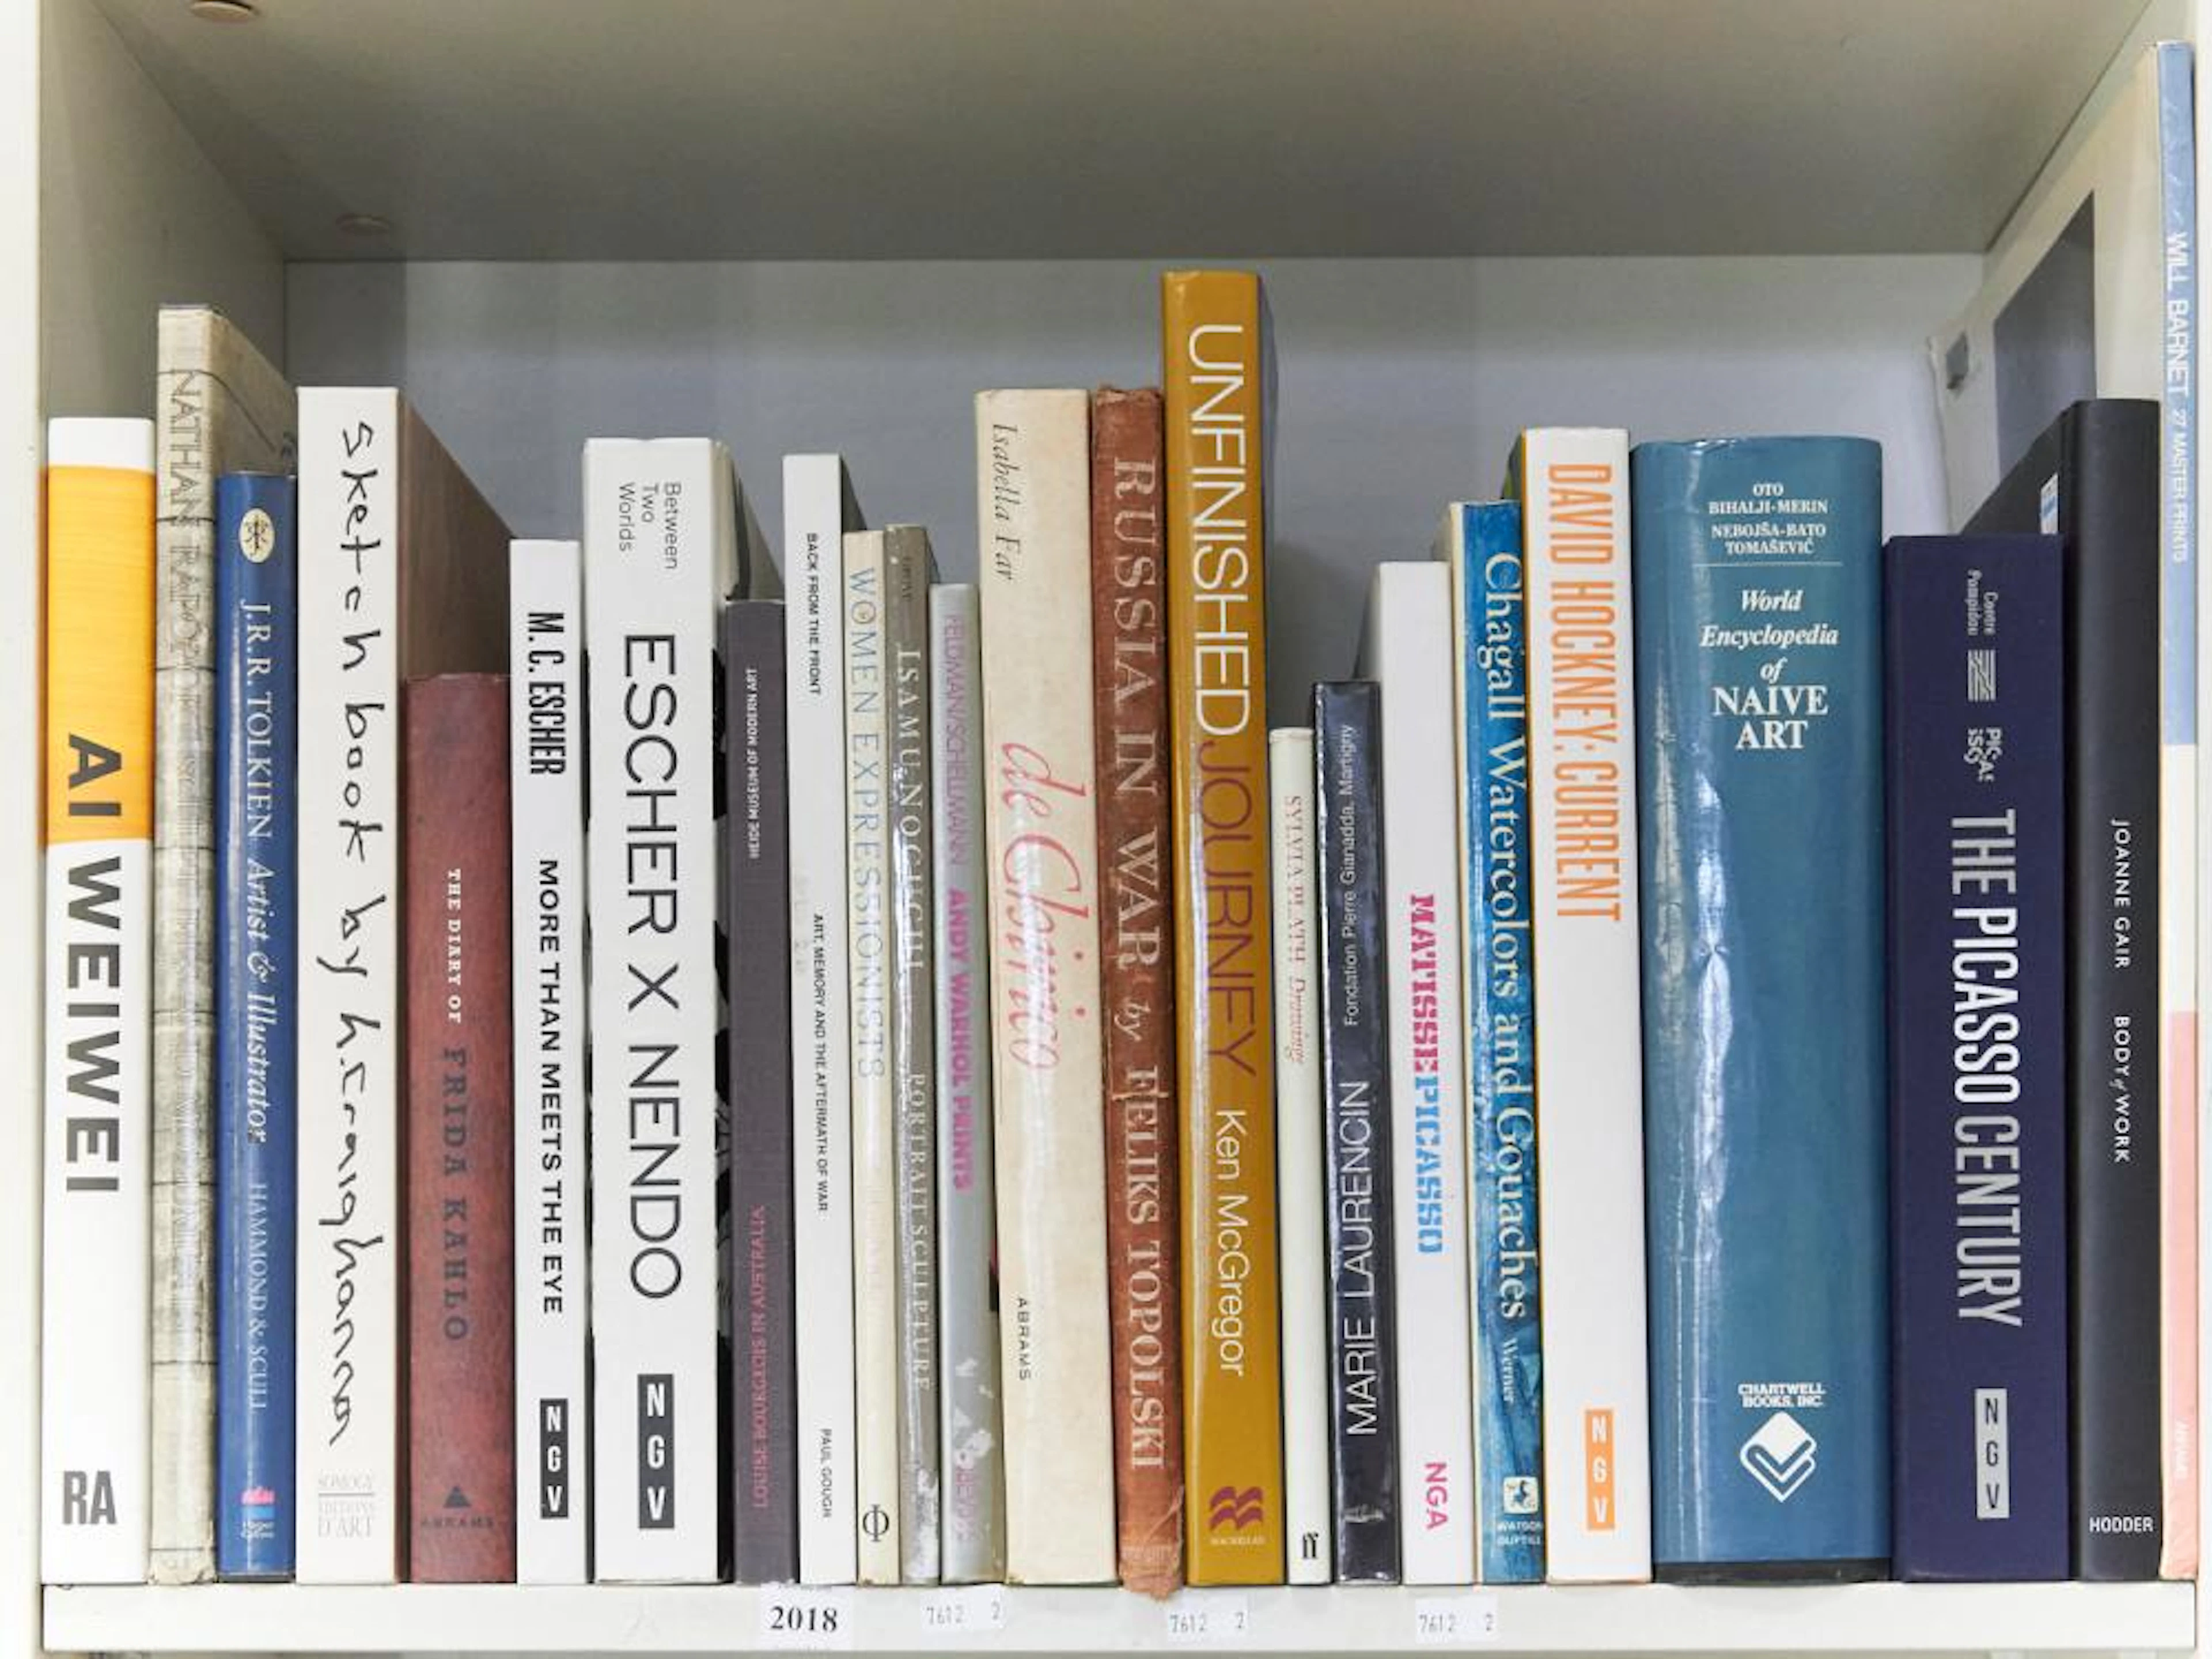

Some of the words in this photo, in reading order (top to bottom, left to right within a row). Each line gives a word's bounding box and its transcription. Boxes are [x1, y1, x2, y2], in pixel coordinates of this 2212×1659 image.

[2167, 231, 2188, 289] WILL
[2168, 298, 2190, 397] BARNET
[170, 372, 202, 529] NATHAN
[2171, 409, 2186, 426] 27
[993, 424, 1019, 520] Isabella
[1753, 483, 1784, 497] OTO
[2172, 433, 2187, 497] MASTER
[618, 482, 635, 552] Worlds
[641, 484, 658, 523] Two
[664, 482, 681, 569] Between
[1189, 323, 1250, 735] UNFINISHED
[1550, 464, 1613, 564] DAVID
[1709, 500, 1828, 514] BIHALJI-MERIN
[2172, 503, 2188, 562] PRINTS
[342, 422, 381, 671] sketch
[806, 533, 819, 570] BACK
[994, 534, 1019, 580] Far
[1113, 457, 1157, 704] RUSSIA
[529, 612, 564, 642] M.
[808, 576, 819, 615] FROM
[1741, 590, 1804, 611] World
[1965, 569, 1983, 635] Pompidou
[1983, 592, 1999, 634] Centre
[240, 599, 273, 685] J.R.R.
[529, 650, 565, 671] C.
[808, 620, 820, 645] THE
[850, 568, 880, 713] WOMEN
[1478, 553, 1527, 719] Chagall
[1699, 624, 1839, 650] Encyclopedia
[746, 668, 758, 691] ART
[809, 650, 821, 695] FRONT
[1711, 685, 1828, 715] NAIVE
[1760, 657, 1788, 683] of
[529, 681, 566, 775] ESCHER
[747, 693, 759, 746] MODERN
[897, 649, 921, 767] ISAMU
[1735, 721, 1809, 749] ART
[69, 734, 122, 817] AI
[247, 691, 273, 838] TOLKIEN
[340, 702, 385, 862] book
[626, 635, 677, 935] ESCHER
[748, 749, 759, 764] OF
[1001, 743, 1086, 817] de
[1115, 730, 1157, 795] IN
[1338, 725, 1357, 795] Martigny
[748, 767, 760, 819] MUSEUM
[749, 821, 760, 859] HEIDE
[1488, 736, 1532, 997] Watercolors
[1555, 762, 1620, 920] CURRENT
[1952, 809, 2017, 894] THE
[2111, 819, 2131, 907] JOANNE
[247, 858, 275, 941] Artist
[448, 868, 461, 909] THE
[539, 859, 560, 952] MORE
[853, 734, 884, 1077] EXPRESSIONISTS
[1117, 831, 1159, 971] WAR
[1199, 740, 1256, 1076] JOURNEY
[1342, 891, 1357, 937] Pierre
[317, 895, 386, 978] by
[448, 919, 462, 985] DIARY
[948, 888, 972, 963] ANDY
[1001, 834, 1089, 1068] Chirico
[2114, 916, 2131, 968] GAIR
[248, 952, 274, 983] &
[628, 965, 679, 1011] X
[814, 948, 825, 1005] MEMORY
[1342, 945, 1358, 1025] Fondation
[68, 855, 121, 1191] WEIWEI
[448, 995, 461, 1024] OF
[540, 961, 560, 1051] THAN
[815, 1010, 826, 1037] AND
[950, 973, 972, 1087] WARHOL
[1115, 998, 1151, 1041] by
[1953, 907, 2021, 1102] PICASSO
[247, 993, 275, 1142] Illustrator
[815, 1043, 827, 1067] THE
[1496, 1014, 1532, 1094] and
[2114, 1016, 2131, 1076] BODY
[444, 1047, 467, 1176] FRIDA
[542, 1065, 562, 1171] MEETS
[816, 1073, 828, 1153] AFTERMATH
[909, 1074, 926, 1211] PORTRAIT
[953, 1096, 975, 1191] PRINTS
[1122, 1066, 1161, 1225] FELIKS
[1214, 1110, 1247, 1180] Ken
[2114, 1093, 2131, 1162] WORK
[630, 1044, 681, 1299] NENDO
[817, 1158, 828, 1177] OF
[817, 1180, 828, 1210] WAR
[1339, 1082, 1375, 1297] LAURENCIN
[248, 1182, 268, 1310] HAMMOND
[543, 1180, 562, 1243] THE
[1497, 1108, 1538, 1319] Gouaches
[1956, 1116, 2023, 1326] CENTURY
[444, 1198, 468, 1340] KAHLO
[544, 1255, 563, 1313] EYE
[1211, 1195, 1248, 1376] McGregor
[248, 1318, 268, 1336] &
[751, 1313, 766, 1332] IN
[911, 1225, 931, 1391] SCULPTURE
[1017, 1298, 1032, 1381] ABRAMS
[752, 1339, 768, 1440] BOURGEOIS
[1127, 1239, 1166, 1470] TOPOLSKI
[1344, 1319, 1377, 1434] MARIE
[1501, 1338, 1518, 1404] Werner
[1738, 1382, 1825, 1395] CHARTWELL
[547, 1406, 562, 1512] NGV
[647, 1384, 665, 1520] NGV
[753, 1446, 768, 1508] LOUISE
[820, 1429, 832, 1463] PAUL
[1593, 1415, 1607, 1522] NGV
[1985, 1398, 1999, 1509] NGV
[63, 1471, 118, 1524] RA
[821, 1468, 833, 1518] GOUGH
[1426, 1462, 1448, 1529] NGA
[2089, 1517, 2154, 1532] HODDER
[771, 1606, 838, 1631] 2018
[1171, 1613, 1208, 1633] 7612
[1236, 1612, 1245, 1630] 2
[1418, 1613, 1456, 1633] 7612
[1486, 1613, 1494, 1631] 2
